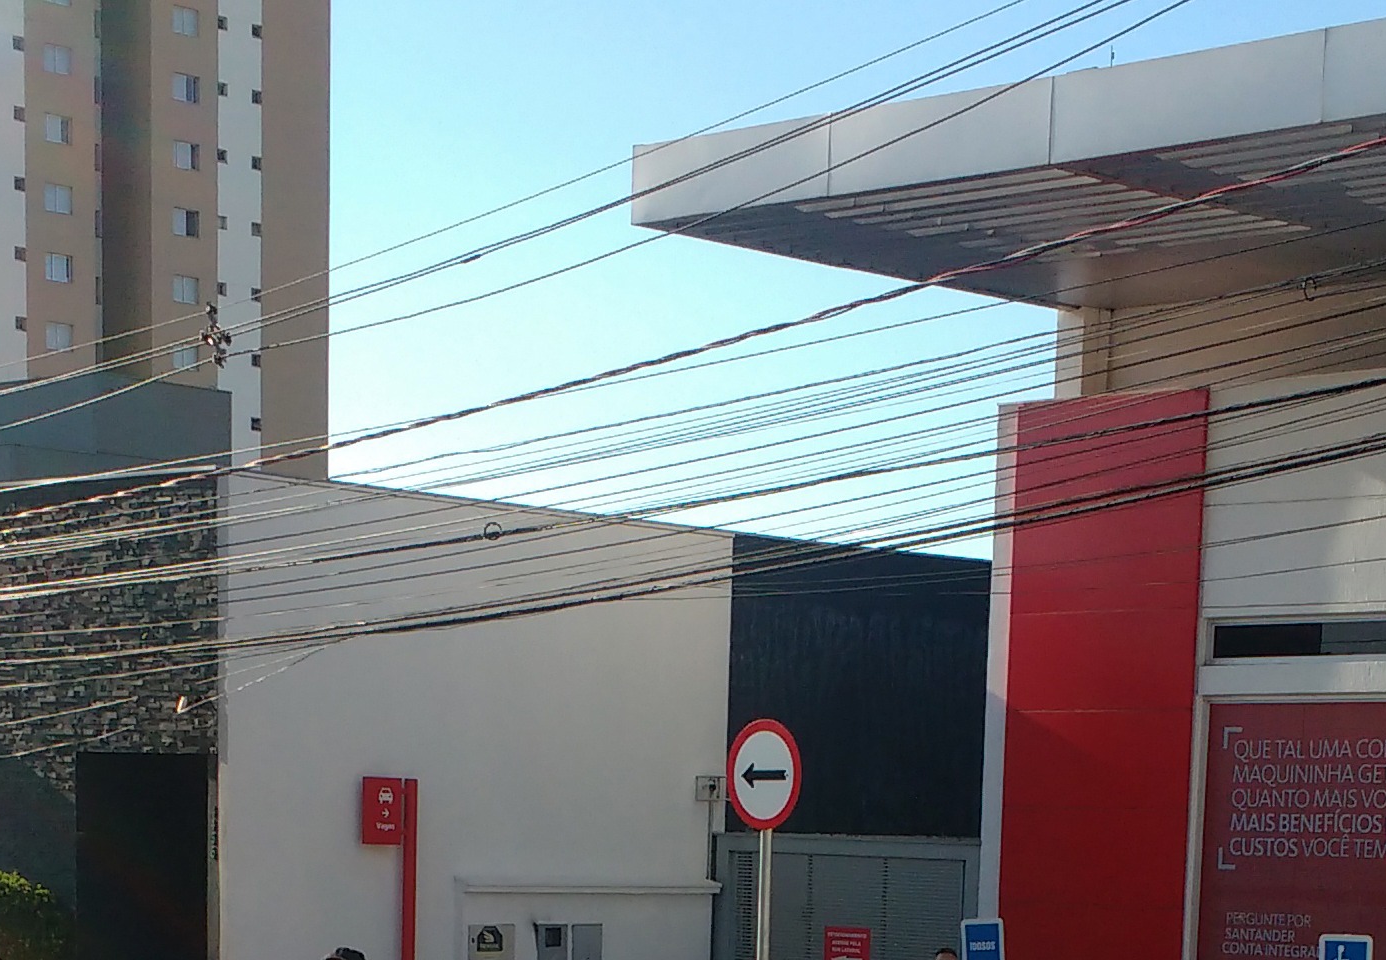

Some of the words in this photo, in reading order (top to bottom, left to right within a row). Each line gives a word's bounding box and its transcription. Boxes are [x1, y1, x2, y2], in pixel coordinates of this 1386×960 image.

[1233, 738, 1272, 763] QUE
[1275, 739, 1305, 759] TAL
[1309, 739, 1353, 759] UMA
[1232, 764, 1355, 788] MAQUININHA
[1231, 788, 1310, 811] QUANTO
[1312, 788, 1358, 809] MAIS
[1229, 813, 1276, 833] MAIS
[1278, 808, 1383, 834] BENEFÍCIOS
[1228, 837, 1299, 858] CUSTOS
[1301, 833, 1351, 858] VOCÊ
[1225, 911, 1286, 927] PERGUNTE
[1287, 914, 1312, 928] POR
[1224, 927, 1296, 943] SANTANDER
[1221, 942, 1264, 956] CONTA
